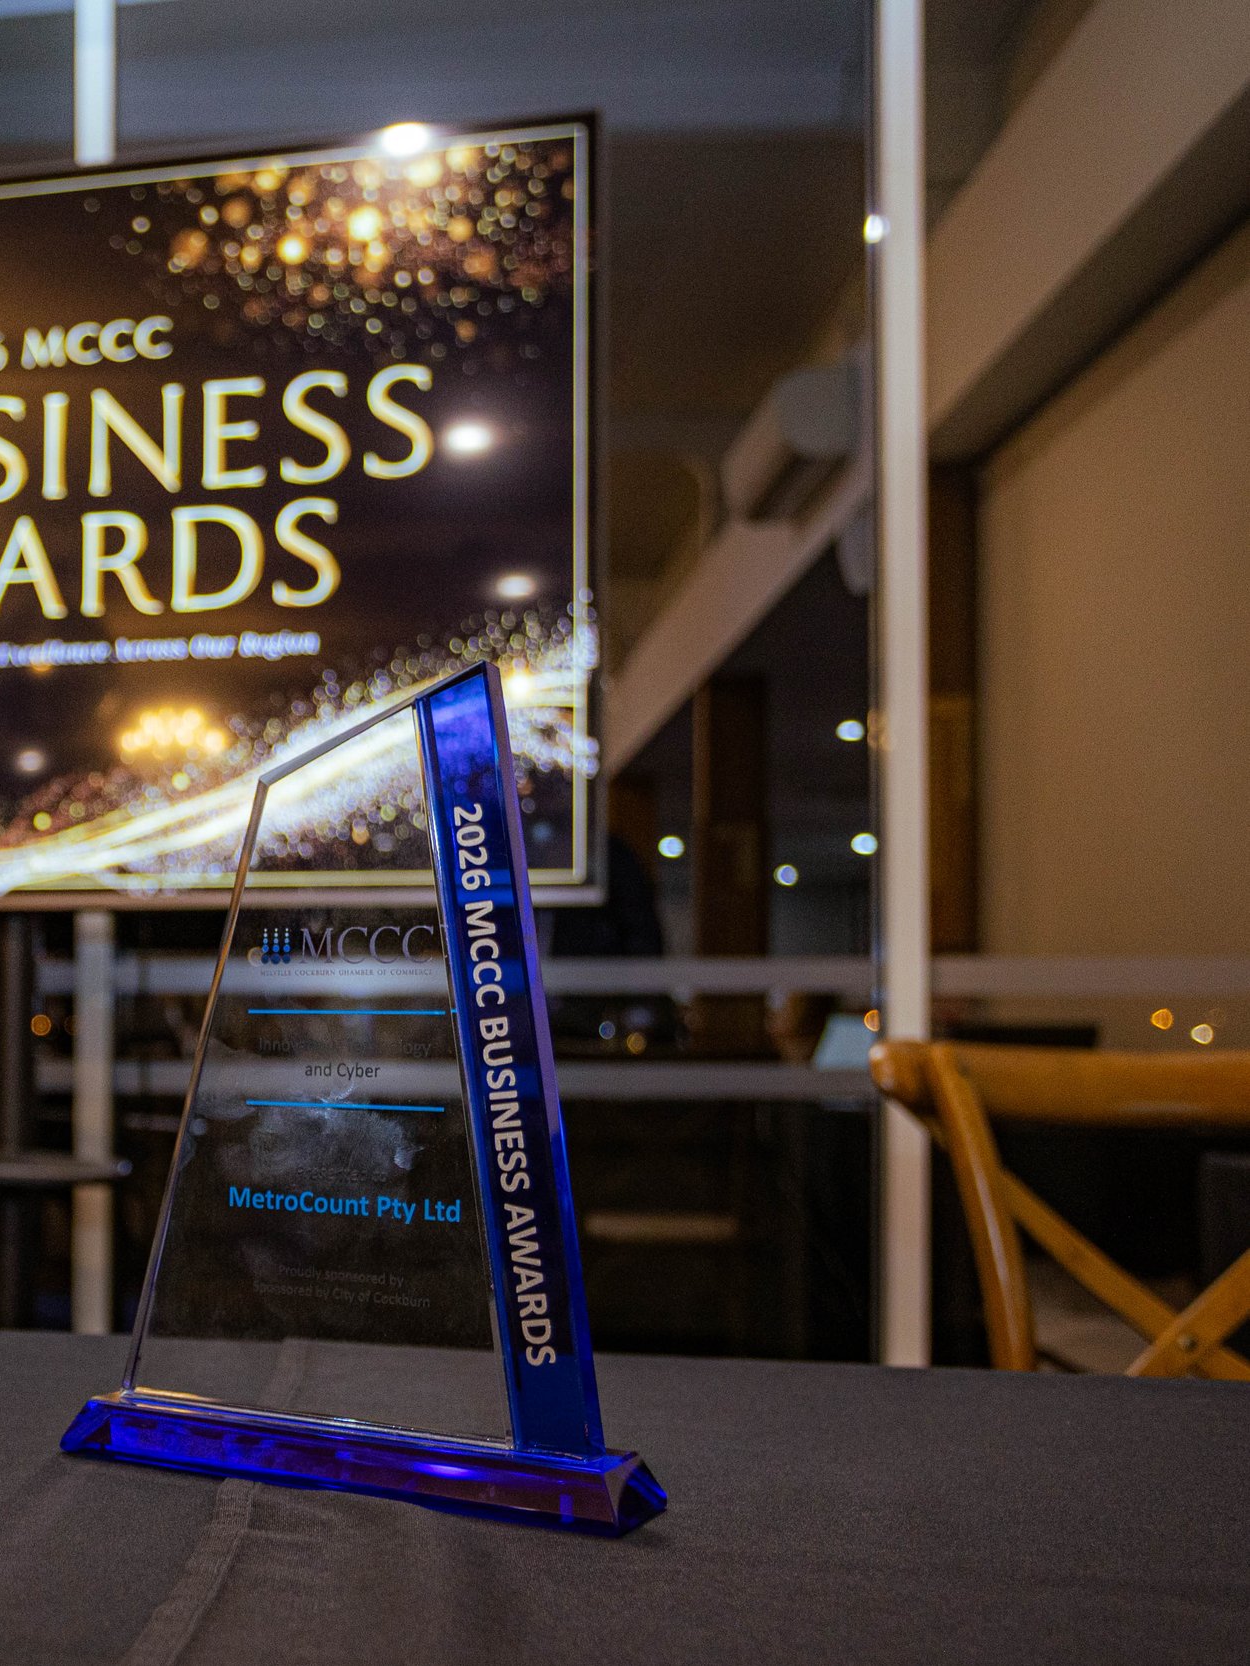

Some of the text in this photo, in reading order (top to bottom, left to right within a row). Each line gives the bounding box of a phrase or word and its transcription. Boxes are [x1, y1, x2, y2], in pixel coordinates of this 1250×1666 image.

[22, 315, 174, 370] MCCC
[300, 926, 435, 965] MCCC
[305, 1062, 381, 1081] and Cyber
[453, 803, 557, 1367] 2026 MCCC BUSINESS AWARDS
[228, 1186, 461, 1224] MetroCount Pty Ltd
[390, 1273, 405, 1288] by
